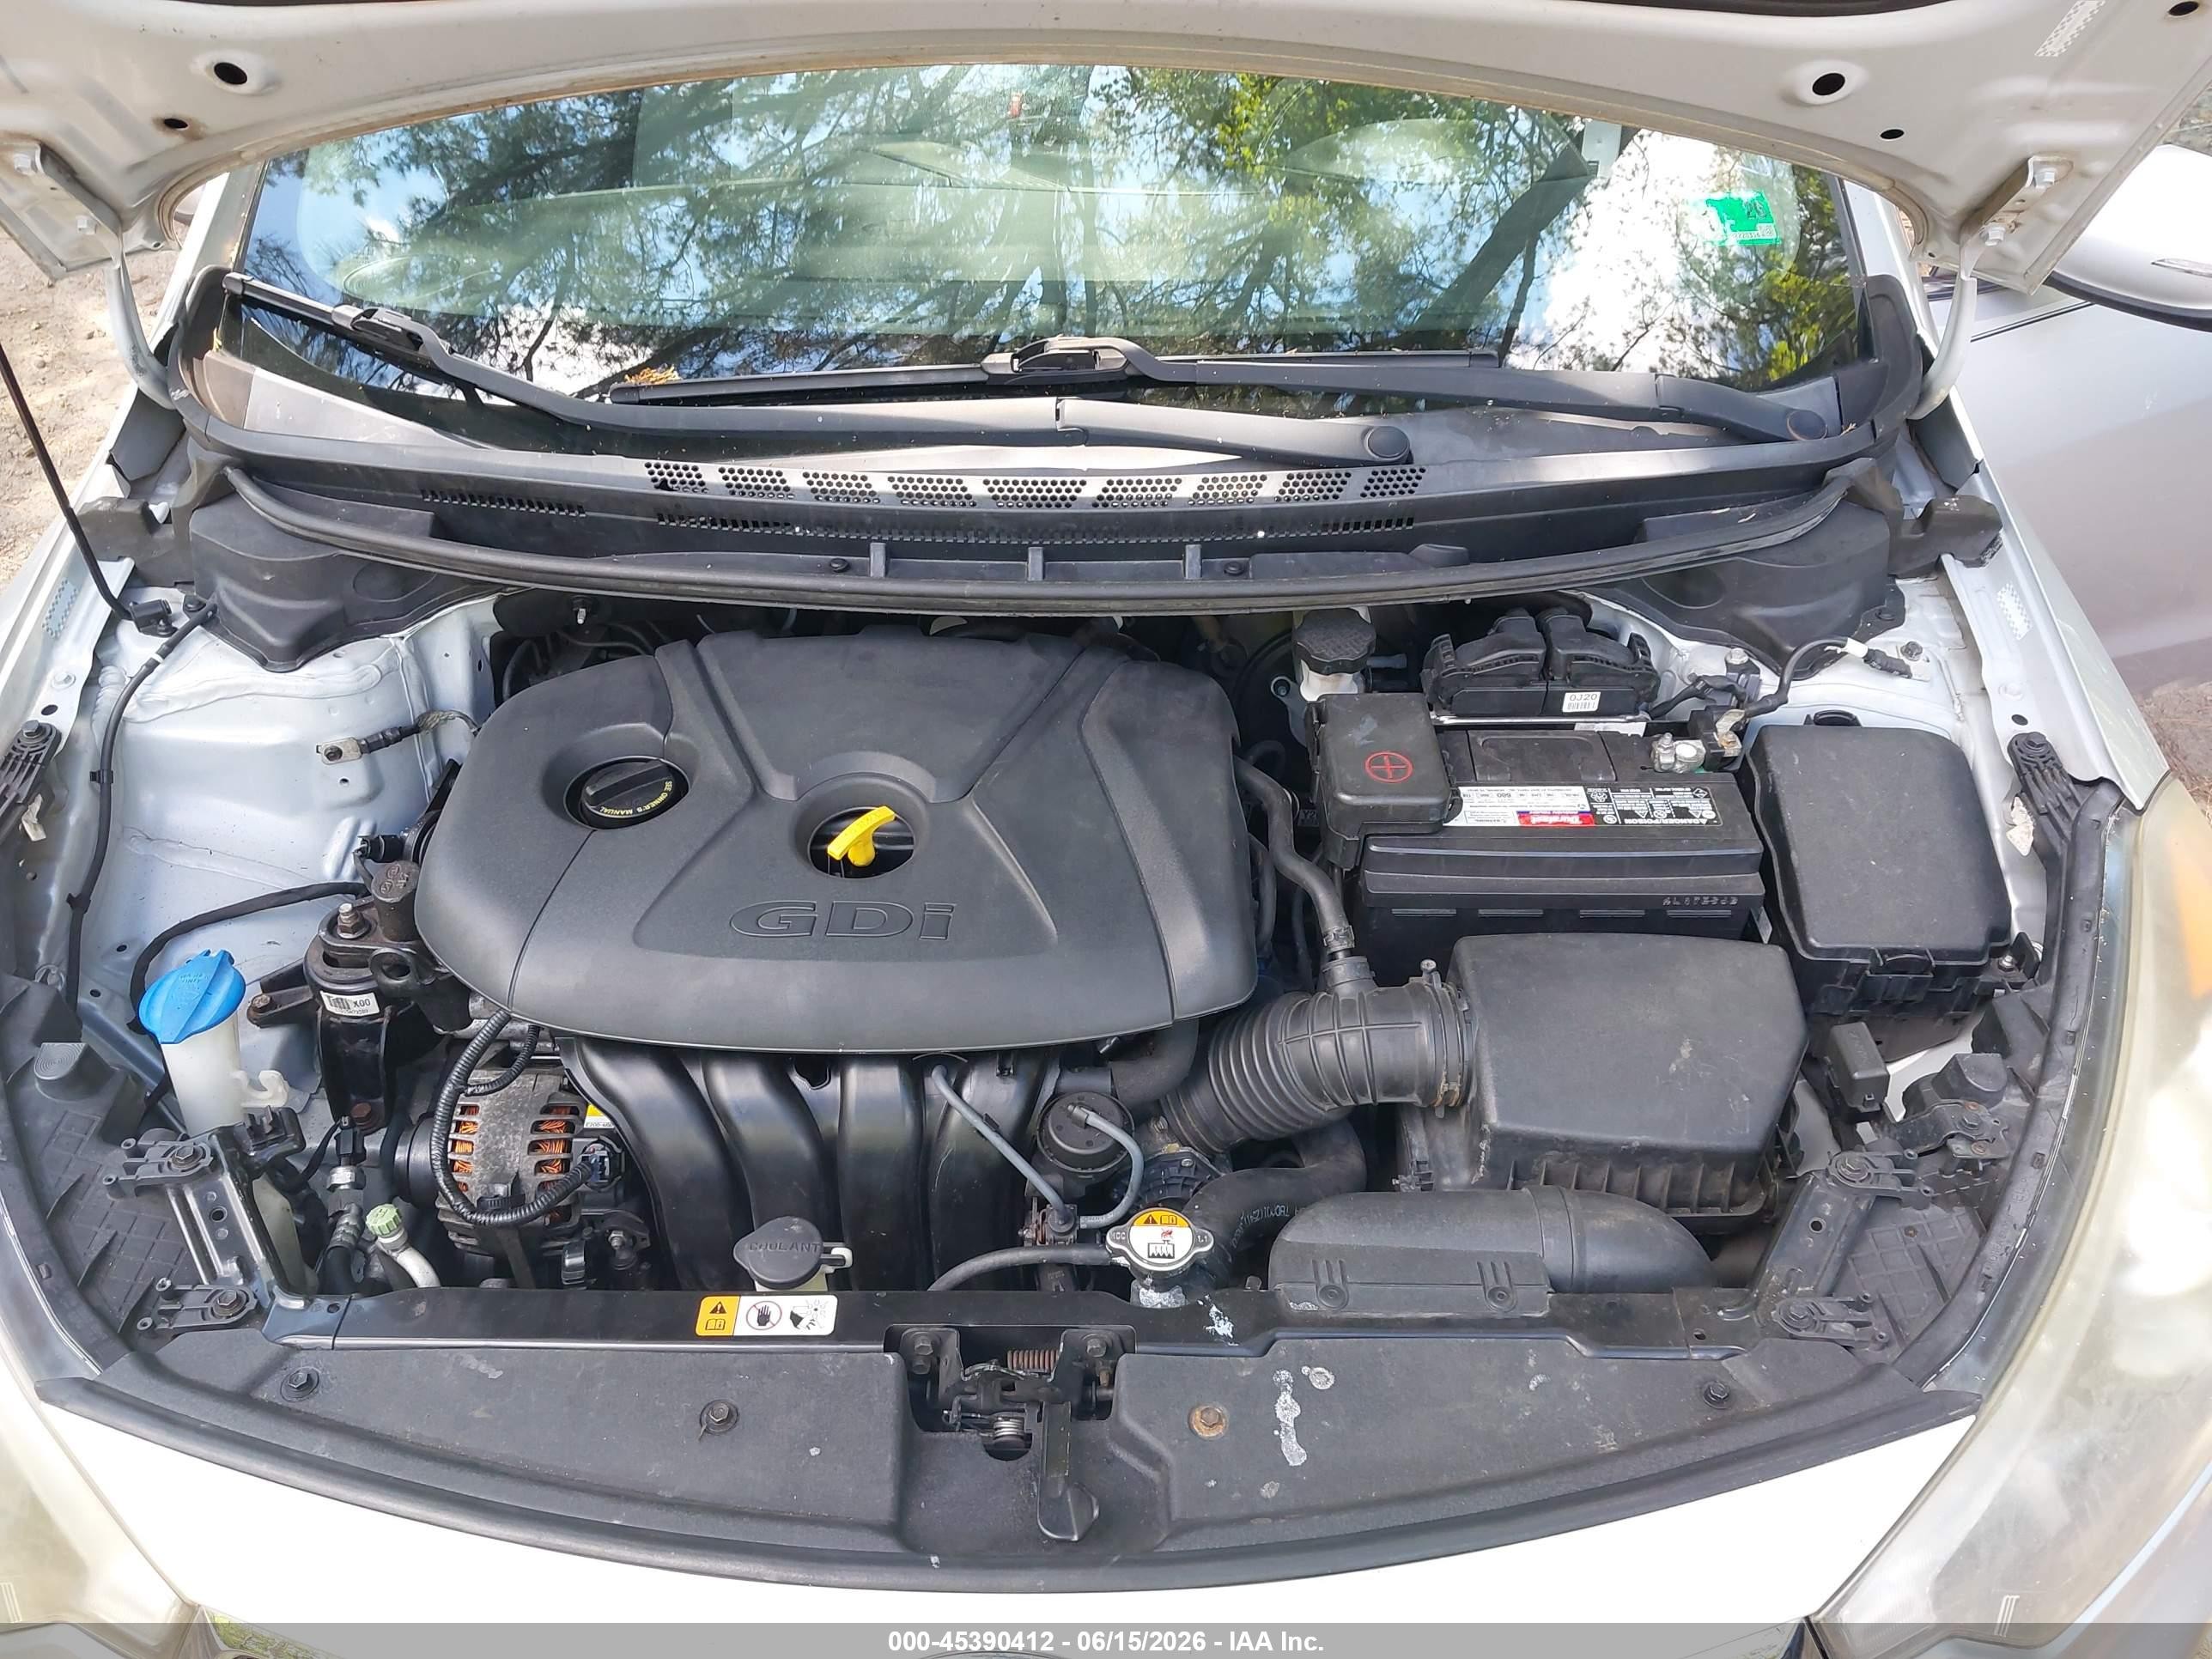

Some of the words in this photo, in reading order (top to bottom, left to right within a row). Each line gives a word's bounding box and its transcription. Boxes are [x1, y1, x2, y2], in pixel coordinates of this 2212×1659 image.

[664, 781, 672, 792] SEE
[599, 806, 633, 815] MANUAL
[730, 900, 957, 941] GDi
[749, 1242, 822, 1254] COOLANT
